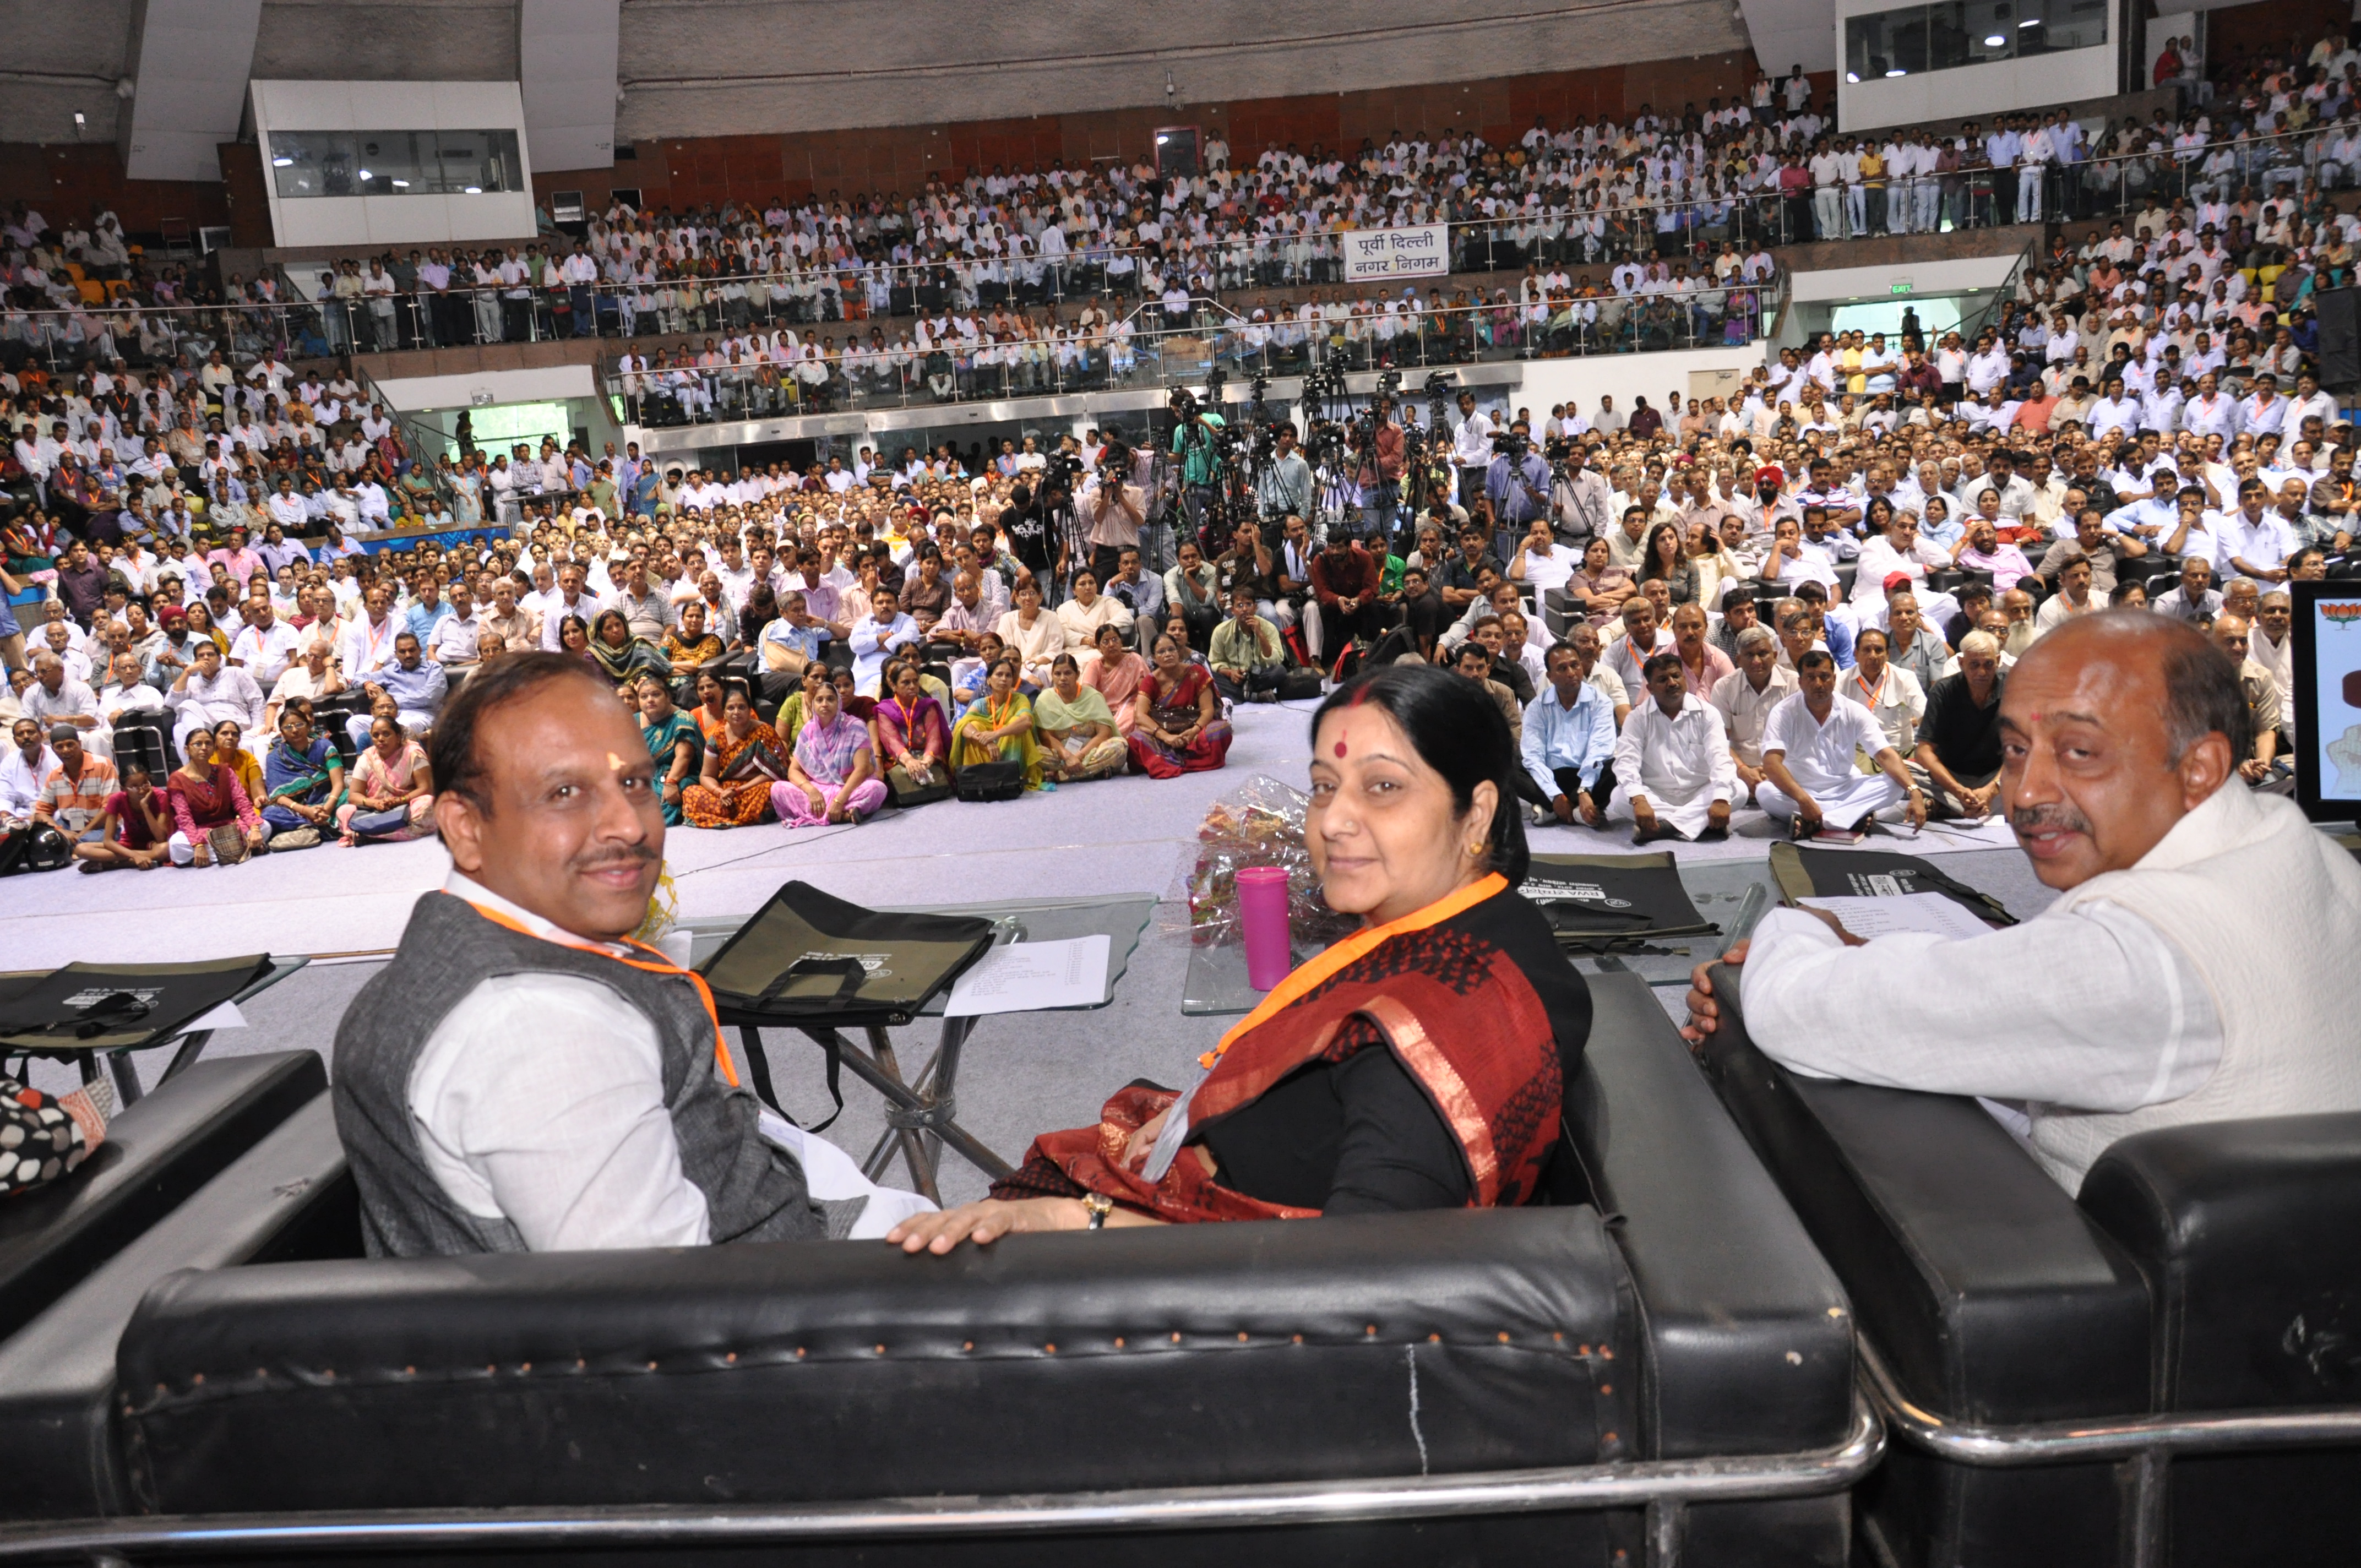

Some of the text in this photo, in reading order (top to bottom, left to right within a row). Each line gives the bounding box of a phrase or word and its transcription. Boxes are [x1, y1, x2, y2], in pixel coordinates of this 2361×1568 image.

[1358, 231, 1434, 255] पूर्वी दिल्ली
[1355, 255, 1439, 273] नगर निगम
[1892, 285, 1912, 293] EXIT
